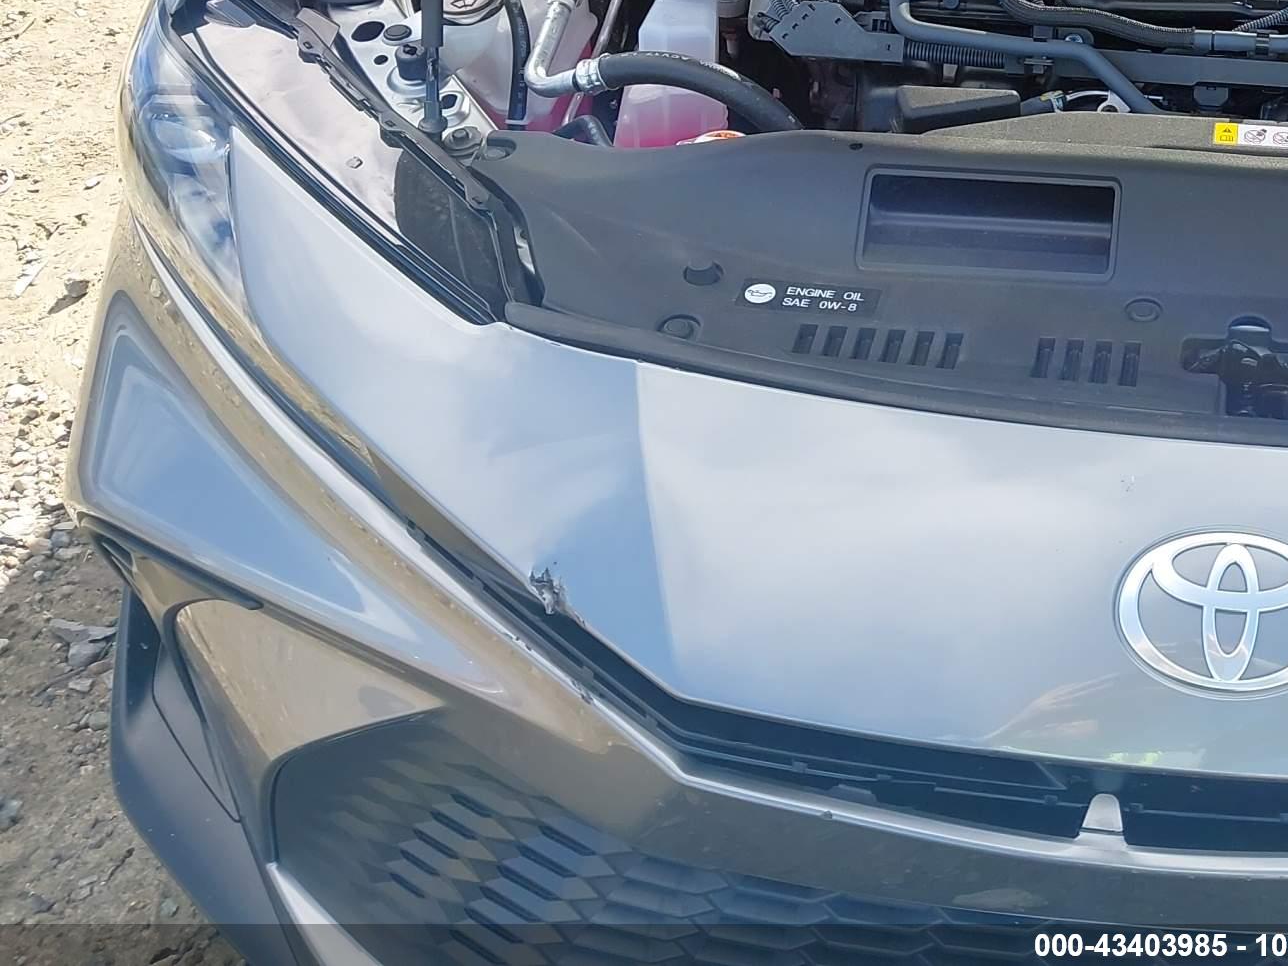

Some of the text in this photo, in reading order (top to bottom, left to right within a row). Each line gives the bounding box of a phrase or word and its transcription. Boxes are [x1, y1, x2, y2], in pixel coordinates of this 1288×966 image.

[786, 286, 865, 302] ENGINE OIL
[782, 297, 858, 312] SAE 0W-8
